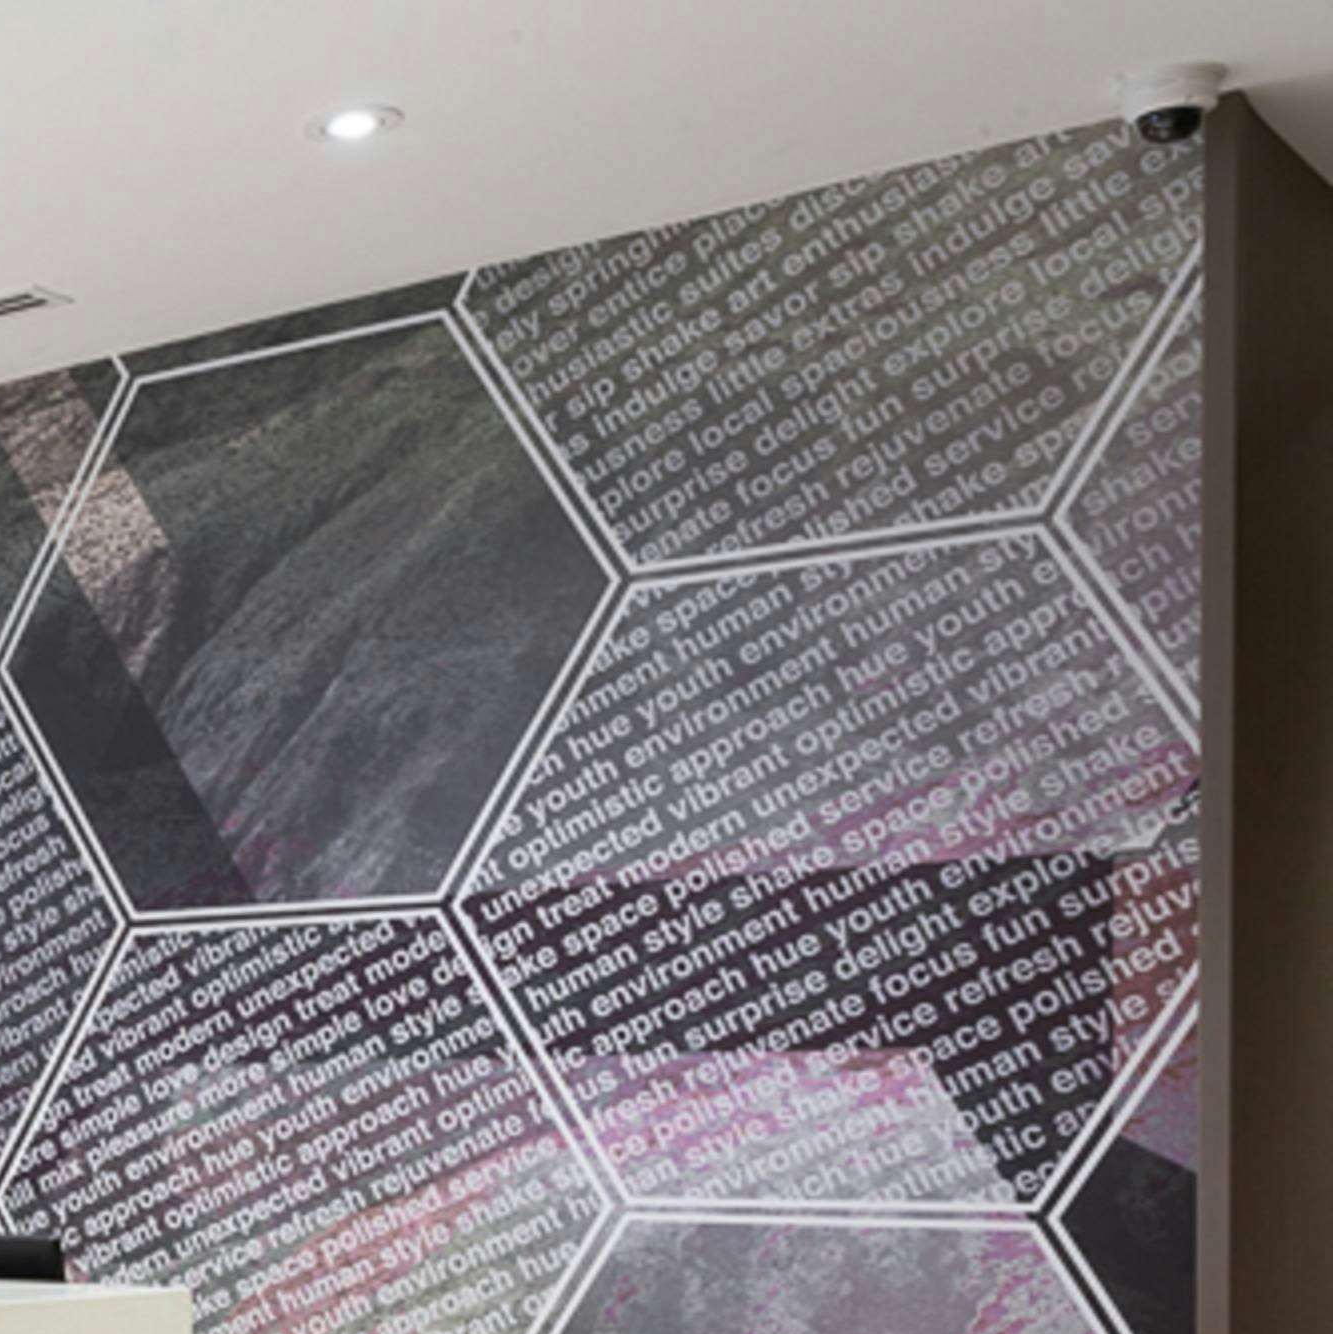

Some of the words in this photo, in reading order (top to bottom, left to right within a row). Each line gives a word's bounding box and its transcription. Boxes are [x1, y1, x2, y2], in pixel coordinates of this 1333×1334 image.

[565, 376, 618, 418] sip
[620, 307, 722, 381] shake
[726, 267, 777, 312] art
[586, 251, 688, 327] entice
[593, 349, 718, 437] indulge
[723, 281, 824, 355] savor
[828, 241, 890, 287] sip
[892, 163, 1007, 245] shake
[678, 227, 783, 305] suites
[689, 389, 773, 454] local
[780, 231, 1036, 399] spaciousness
[1040, 170, 1134, 235] little
[707, 345, 786, 403] little
[791, 271, 904, 351] extras
[908, 175, 1056, 275] indulge
[613, 450, 746, 541] surprise
[750, 366, 878, 455] delight
[882, 279, 1026, 376] explore
[1030, 211, 1129, 285] local
[734, 436, 836, 506] focus
[839, 395, 904, 442] fun
[910, 293, 1072, 400] surprise
[836, 361, 1032, 486] rejuvenate
[1035, 289, 1152, 366] focus
[923, 384, 1065, 477] service
[507, 773, 665, 870] optimistic
[669, 680, 830, 783] approach
[836, 642, 909, 690] hue
[913, 574, 1024, 655] youth
[526, 756, 617, 826] youth
[623, 635, 838, 768] environment
[841, 566, 971, 646] human
[567, 714, 633, 759] hue
[635, 653, 732, 728] youth
[674, 584, 792, 660] human
[481, 809, 662, 921] unexpected
[666, 743, 790, 822] vibrant
[793, 647, 977, 755] optimistic
[526, 944, 636, 1009] human
[642, 900, 725, 953] style
[728, 844, 836, 909] shake
[840, 786, 954, 854] space
[960, 692, 1128, 799] polished
[536, 875, 613, 929] treat
[618, 809, 745, 886] modern
[752, 693, 961, 818] unexpected
[966, 617, 1107, 705] vibrant
[561, 893, 660, 955] space
[665, 811, 811, 907] polished
[817, 744, 953, 824] service
[958, 664, 1098, 751] refresh
[590, 898, 801, 1017] environment
[804, 838, 931, 911] human
[937, 788, 1033, 847] style
[1038, 724, 1163, 797] shake
[99, 997, 188, 1059] vibrant
[190, 925, 321, 1008] optimistic
[591, 964, 746, 1055] approach
[751, 933, 821, 977] hue
[825, 874, 931, 948] youth
[938, 750, 1190, 887] environment
[620, 1041, 678, 1080] fun
[684, 970, 828, 1050] surprise
[830, 903, 963, 980] delight
[967, 834, 1117, 917] explore
[684, 993, 866, 1089] rejuvenate
[867, 942, 978, 1004] focus
[980, 908, 1050, 952] fun
[39, 1158, 84, 1192] mix
[87, 1100, 194, 1172] pleasure
[197, 1061, 266, 1107] more
[269, 1011, 362, 1071] simple
[364, 976, 428, 1020] love
[51, 1168, 120, 1223] youth
[125, 1083, 286, 1181] environment
[288, 1035, 385, 1095] human
[389, 995, 462, 1044] style
[59, 1094, 141, 1149] simple
[143, 1062, 200, 1102] love
[201, 1013, 291, 1071] design
[294, 972, 361, 1022] treat
[73, 1062, 132, 1108] treat
[135, 1010, 232, 1072] modern
[236, 917, 394, 1018] unexpected
[653, 1060, 798, 1149] polished
[804, 1001, 938, 1074] service
[944, 931, 1082, 1011] refresh
[684, 1119, 769, 1169] style
[773, 1068, 881, 1129] shake
[887, 1015, 1002, 1079] space
[1009, 930, 1182, 1031] polished
[1048, 994, 1150, 1051] style
[74, 1216, 161, 1274] vibrant
[164, 1153, 293, 1229] optimistic
[296, 1082, 429, 1163] approach
[433, 1055, 493, 1095] hue
[83, 1161, 199, 1236] approach
[202, 1138, 255, 1174] hue
[258, 1091, 336, 1152] youth
[174, 1168, 327, 1258] unexpected
[330, 1117, 433, 1182] vibrant
[235, 1249, 317, 1299] space
[321, 1186, 442, 1264] polished
[447, 1136, 559, 1200] service
[268, 1186, 365, 1248] refresh
[371, 1114, 525, 1199] rejuvenate
[278, 1258, 374, 1313] human
[379, 1223, 451, 1268] style
[455, 1179, 546, 1233] shake
[376, 1206, 563, 1305] environment
